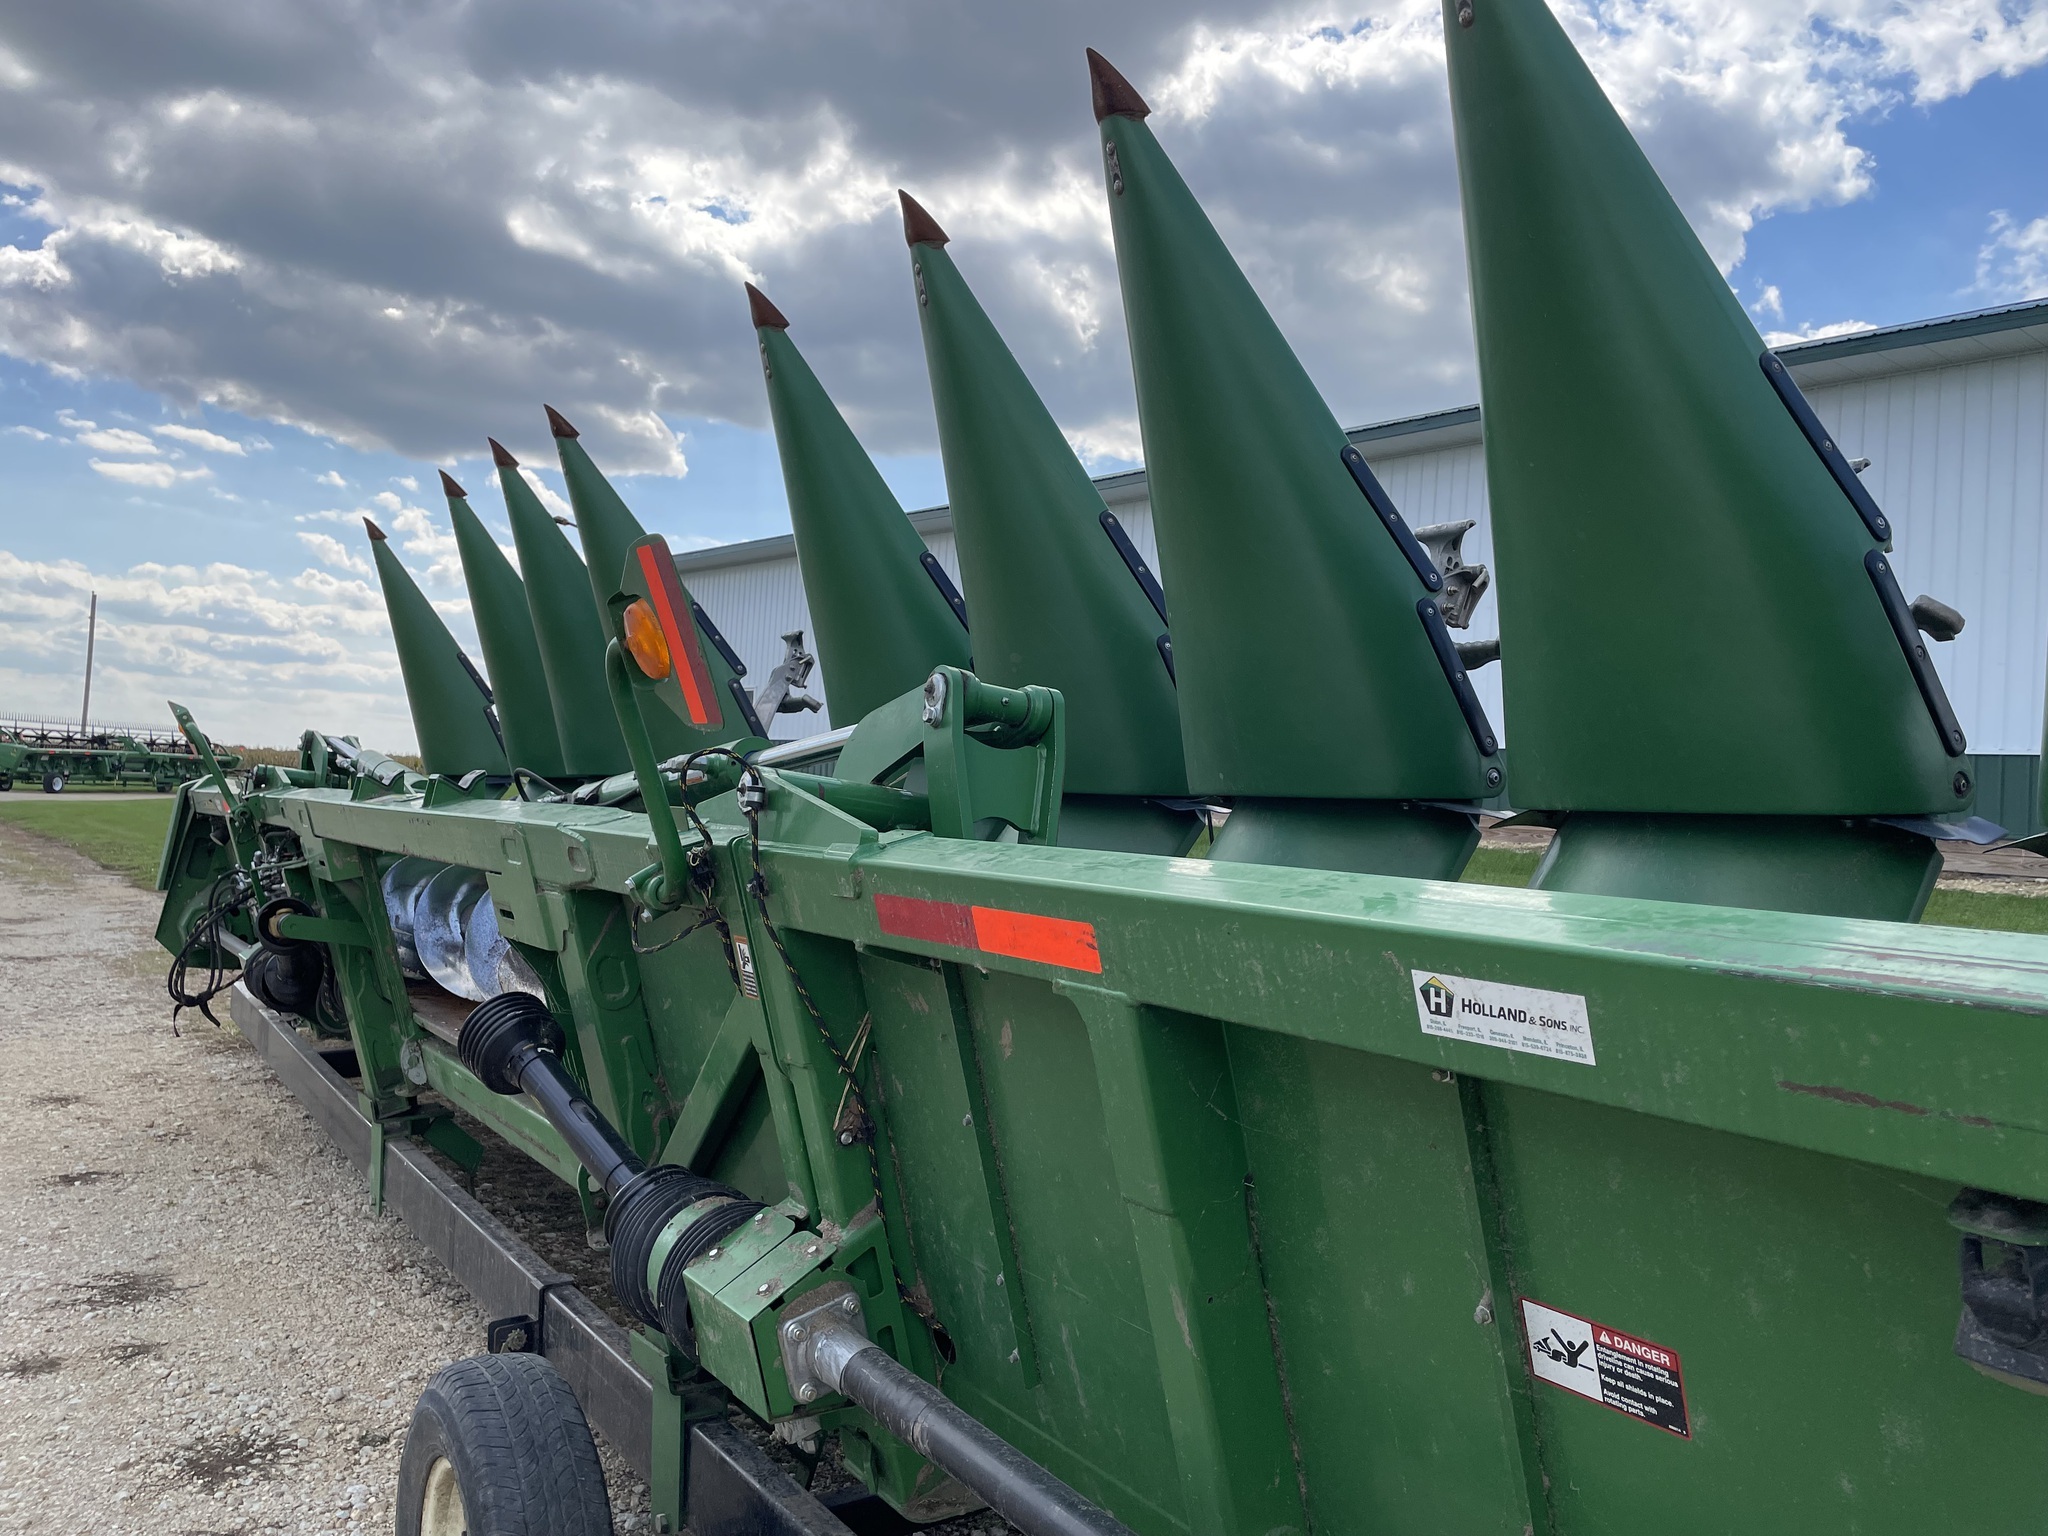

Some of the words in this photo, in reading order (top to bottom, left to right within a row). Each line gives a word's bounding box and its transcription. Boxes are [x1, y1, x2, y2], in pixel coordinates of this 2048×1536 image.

[1461, 997, 1527, 1024] HOLLAND
[1528, 1016, 1537, 1026] &
[1596, 1344, 1637, 1365] Entanglement
[1637, 1359, 1645, 1367] in
[1645, 1363, 1669, 1378] rotating
[1613, 1336, 1670, 1366] DANGER
[1598, 1352, 1623, 1366] driveline
[1623, 1363, 1635, 1371] can
[1636, 1367, 1654, 1378] cause
[1655, 1373, 1679, 1388] serious
[1624, 1369, 1643, 1382] death.
[1601, 1373, 1616, 1385] Keep
[1617, 1380, 1625, 1388] all
[1625, 1384, 1647, 1397] shields
[1647, 1391, 1654, 1400] in
[1655, 1395, 1675, 1408] place.
[1604, 1388, 1620, 1400] Avoid
[1620, 1397, 1643, 1410] contact
[1644, 1404, 1658, 1415] with
[1604, 1396, 1627, 1411] rotating
[1628, 1406, 1646, 1418] parts.
